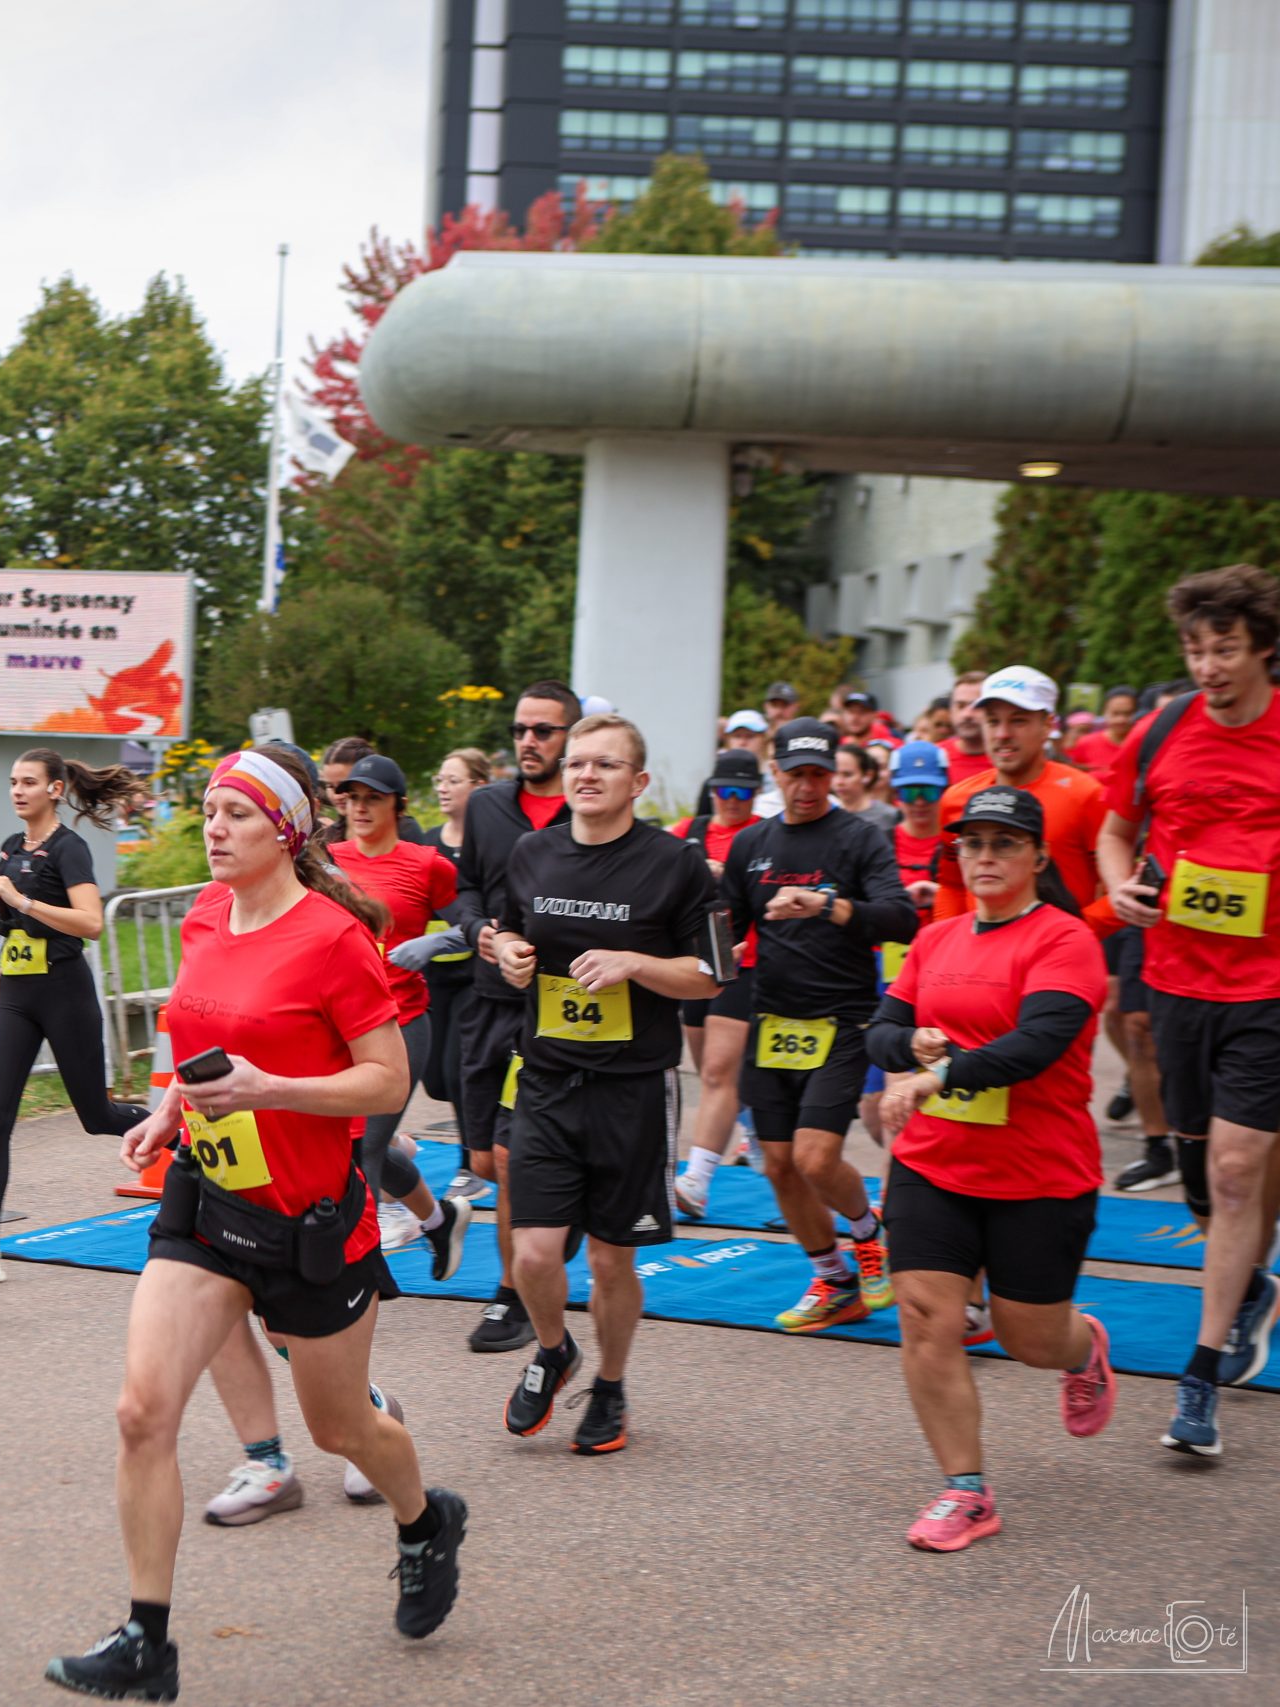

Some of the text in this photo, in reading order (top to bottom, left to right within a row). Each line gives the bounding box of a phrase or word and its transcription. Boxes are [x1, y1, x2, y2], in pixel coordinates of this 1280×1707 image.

[21, 587, 137, 615] Saguenay
[90, 625, 118, 640] en
[5, 653, 83, 670] mauve
[1181, 886, 1248, 917] 205
[562, 999, 603, 1025] 84
[769, 1032, 819, 1056] 263
[194, 1135, 239, 1169] 01
